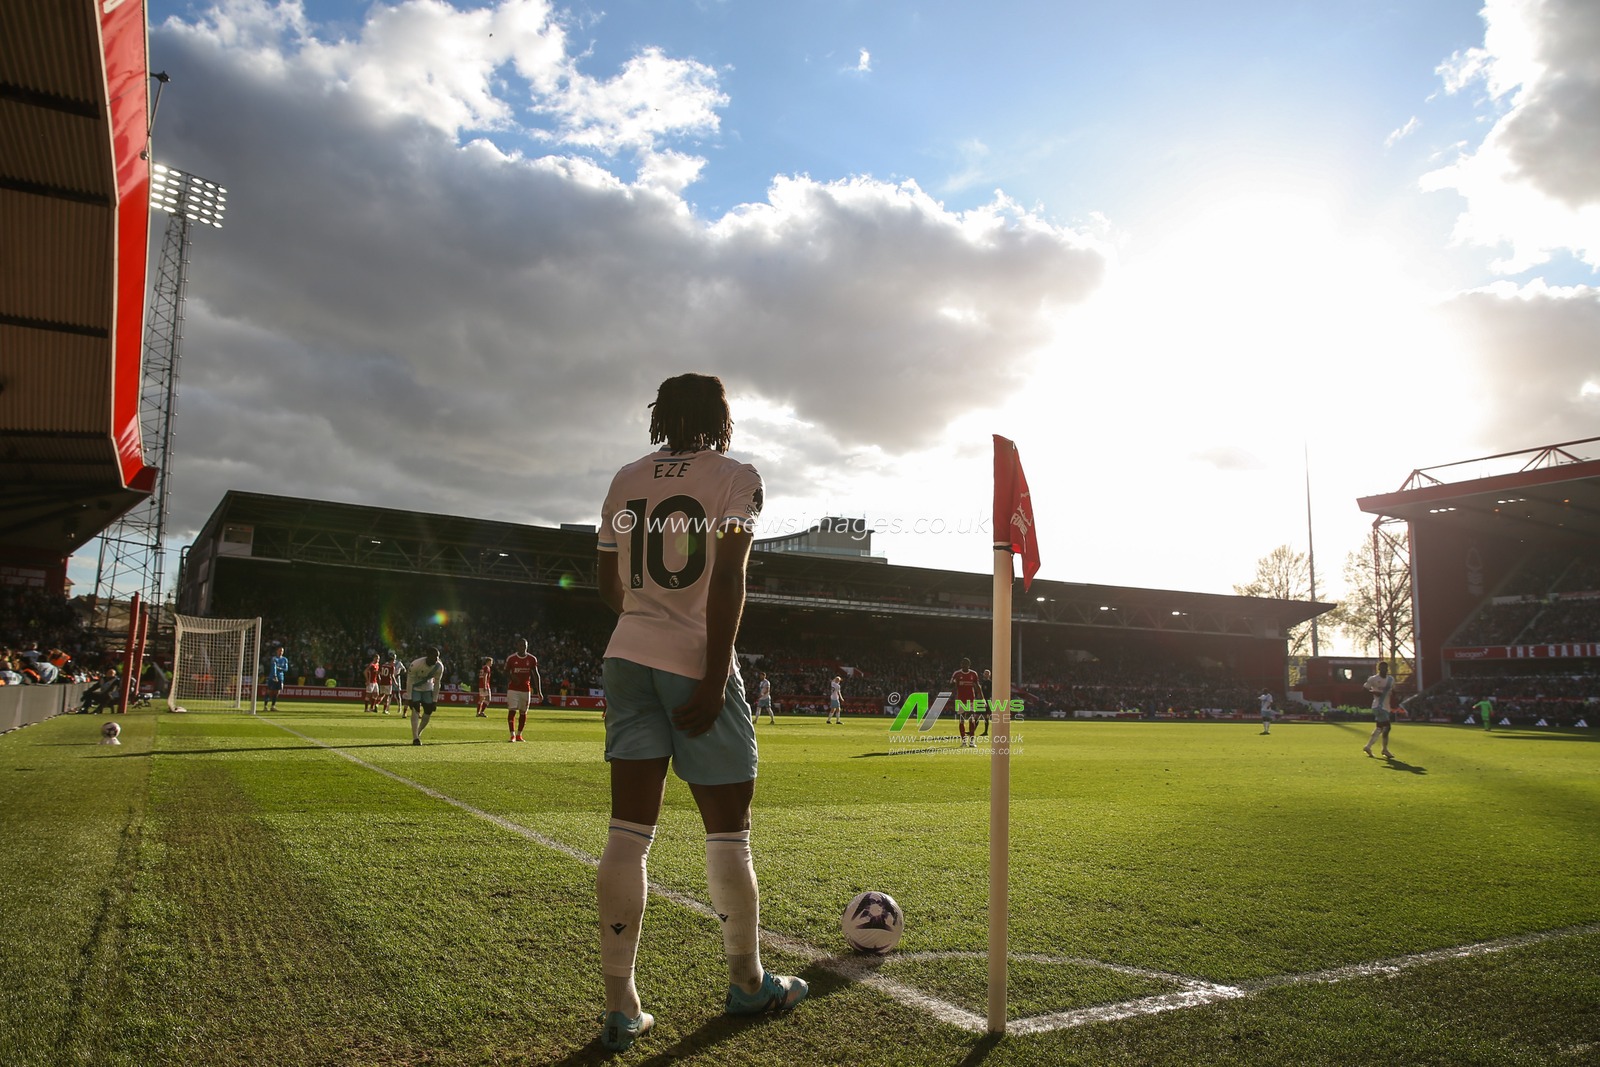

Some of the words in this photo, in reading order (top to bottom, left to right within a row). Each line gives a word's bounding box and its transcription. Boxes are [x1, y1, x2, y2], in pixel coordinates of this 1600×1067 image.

[653, 462, 691, 479] EZE
[625, 493, 708, 590] 10
[1505, 646, 1535, 659] THE
